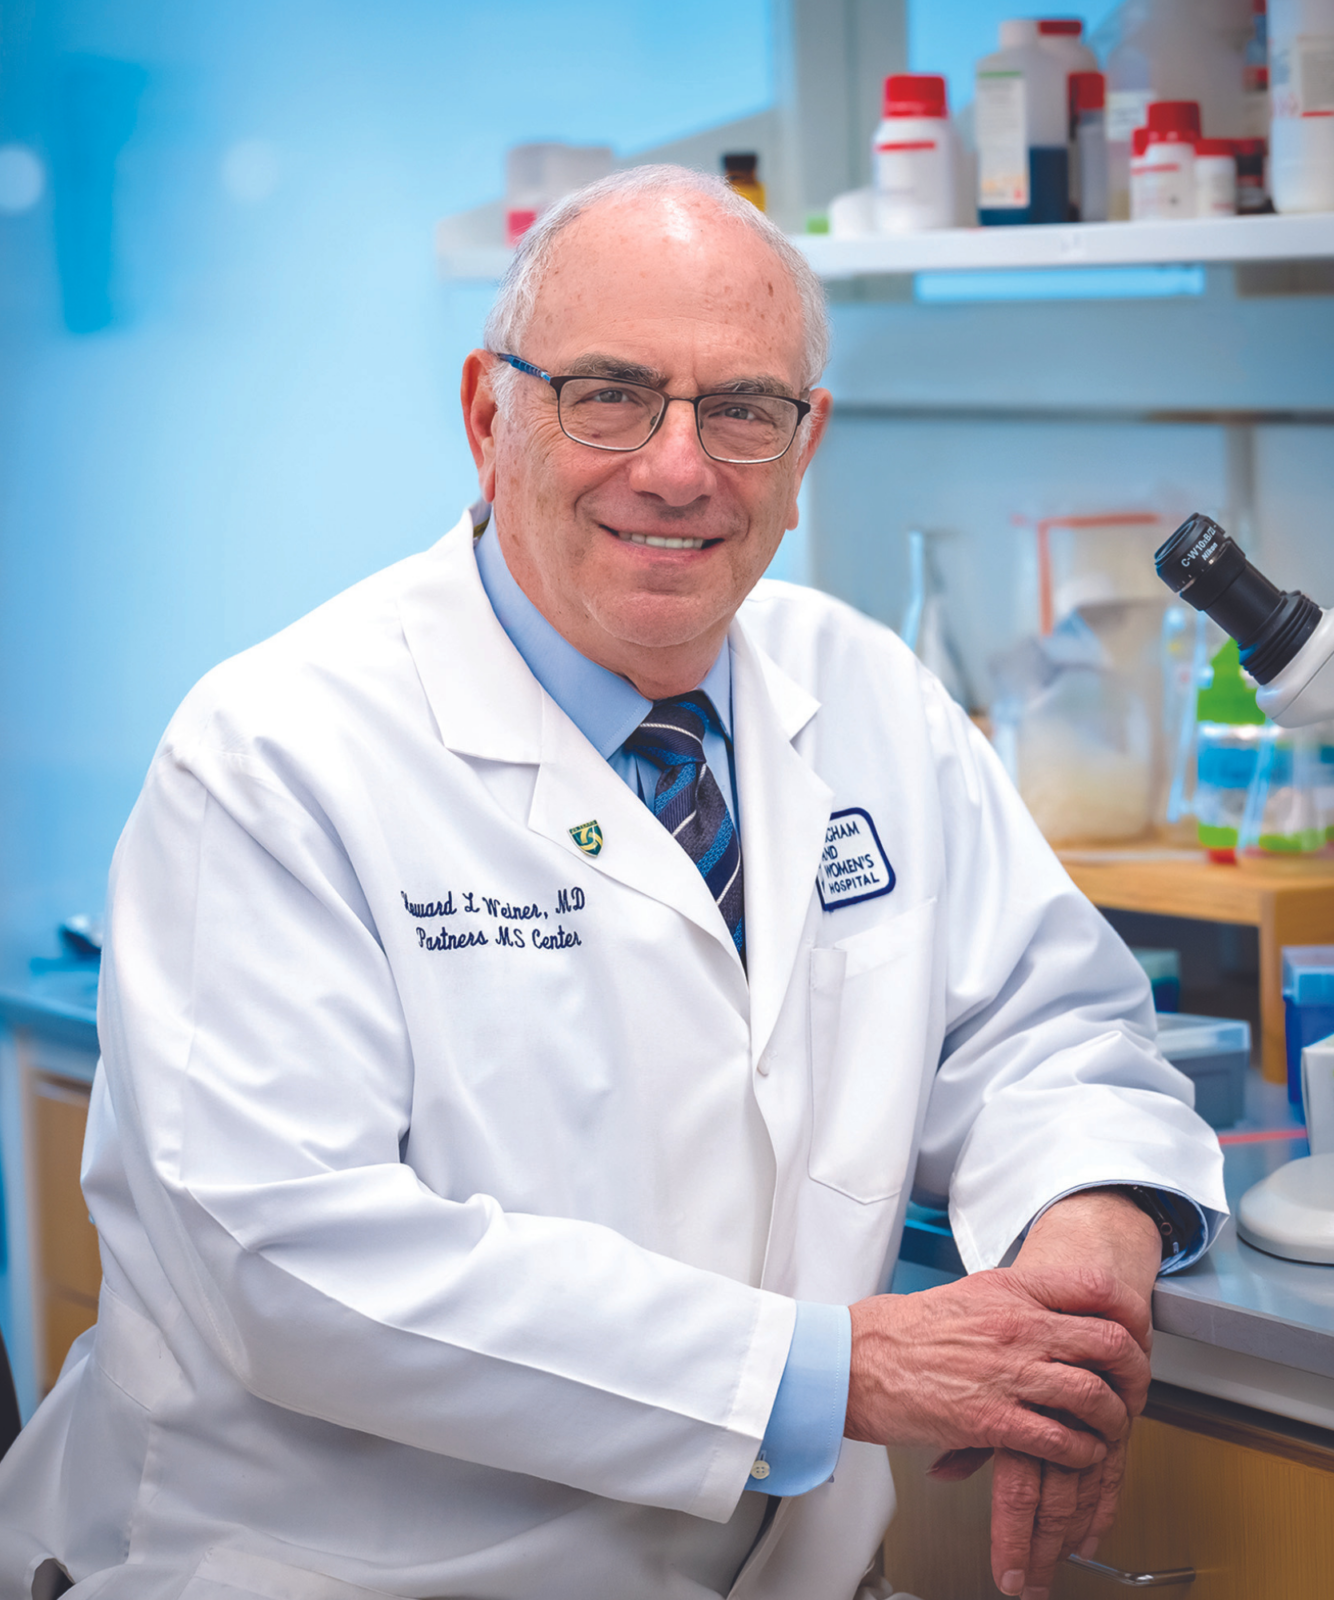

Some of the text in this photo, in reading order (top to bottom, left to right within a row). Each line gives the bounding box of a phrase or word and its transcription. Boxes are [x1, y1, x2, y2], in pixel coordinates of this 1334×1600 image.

[1201, 542, 1218, 561] Nikon
[825, 821, 860, 843] GHAM
[829, 872, 880, 894] HOSPITAL
[482, 897, 548, 920] Weiner,
[555, 886, 585, 914] MD
[416, 925, 582, 951] Partners MS Center
